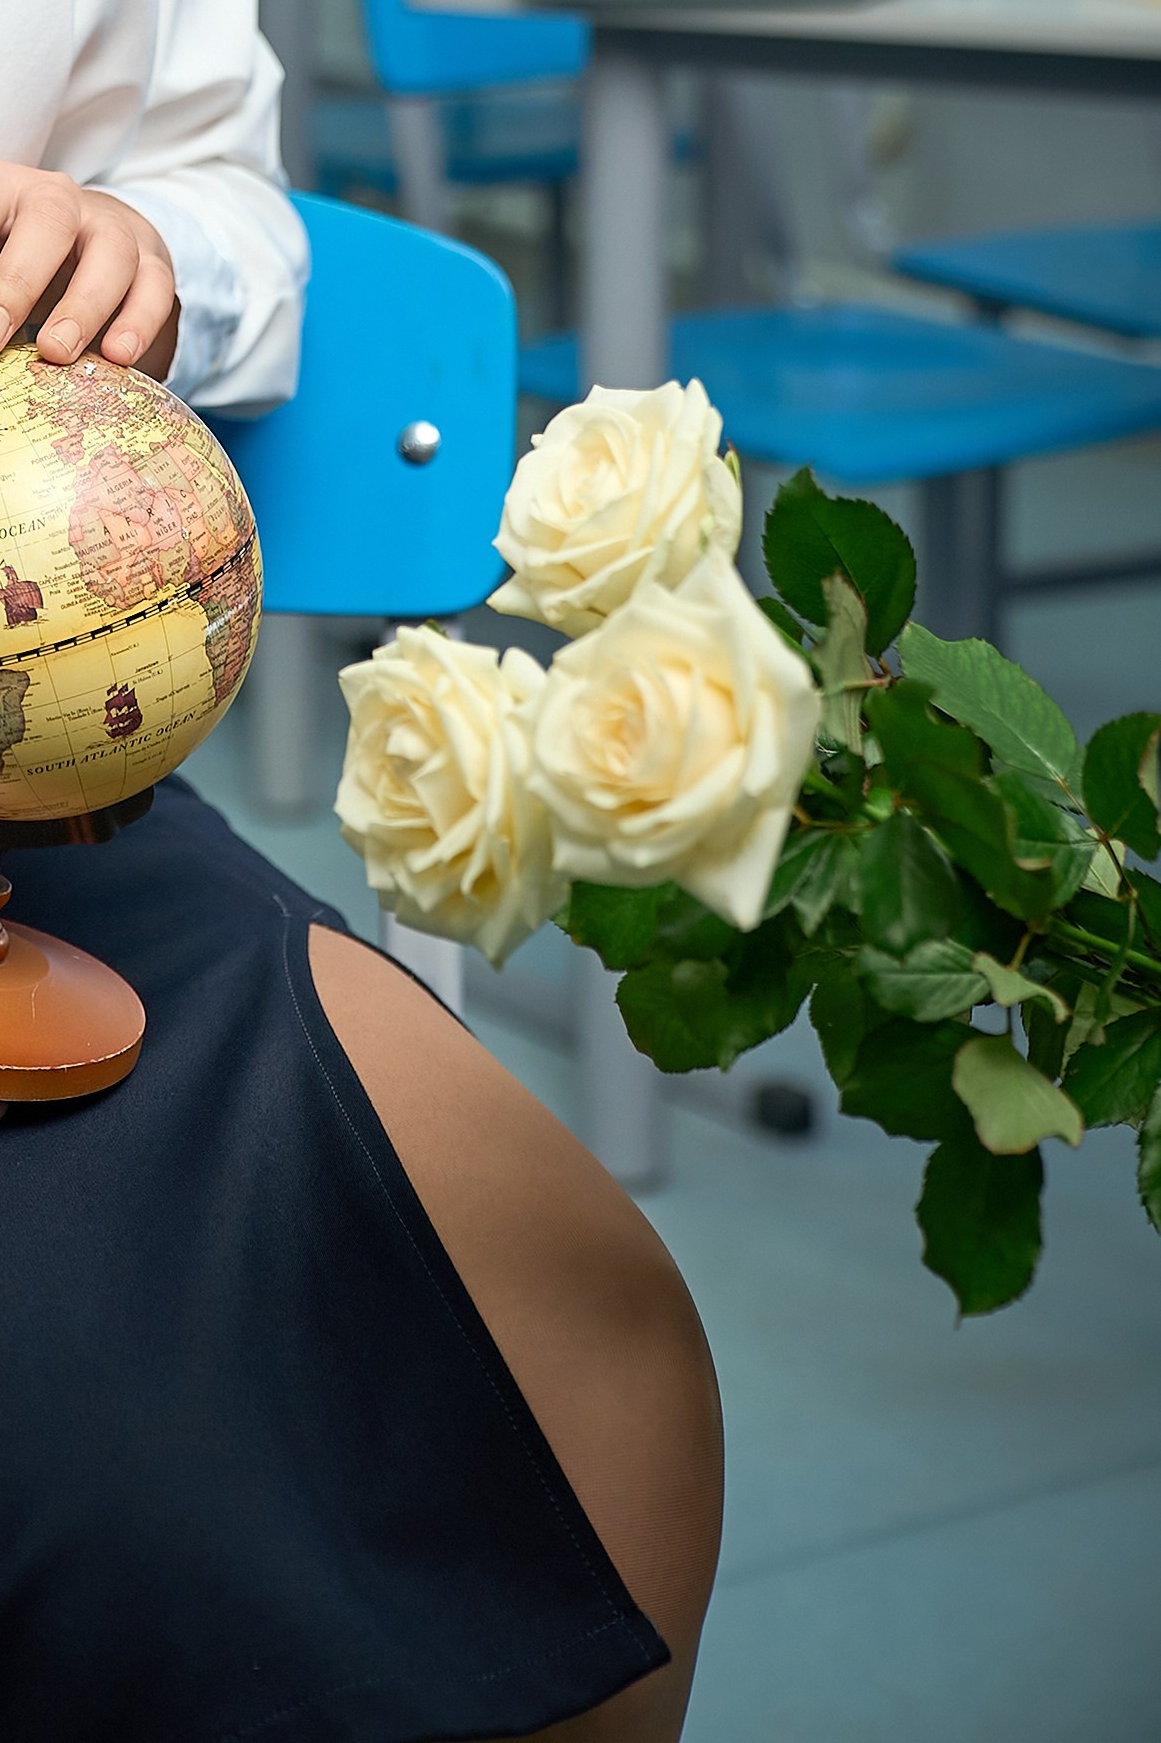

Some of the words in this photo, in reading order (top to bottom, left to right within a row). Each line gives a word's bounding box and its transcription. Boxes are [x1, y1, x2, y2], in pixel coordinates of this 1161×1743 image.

[153, 461, 170, 475] LIBYA
[106, 478, 133, 494] ALGERIA
[119, 529, 138, 542] MALI
[156, 521, 178, 537] NIGER
[77, 538, 113, 558] MAURITANIA
[38, 578, 50, 586] CAPE
[26, 758, 76, 776] SOUTH
[80, 731, 153, 764] ATLANTIC
[155, 710, 197, 738] OCEAN
